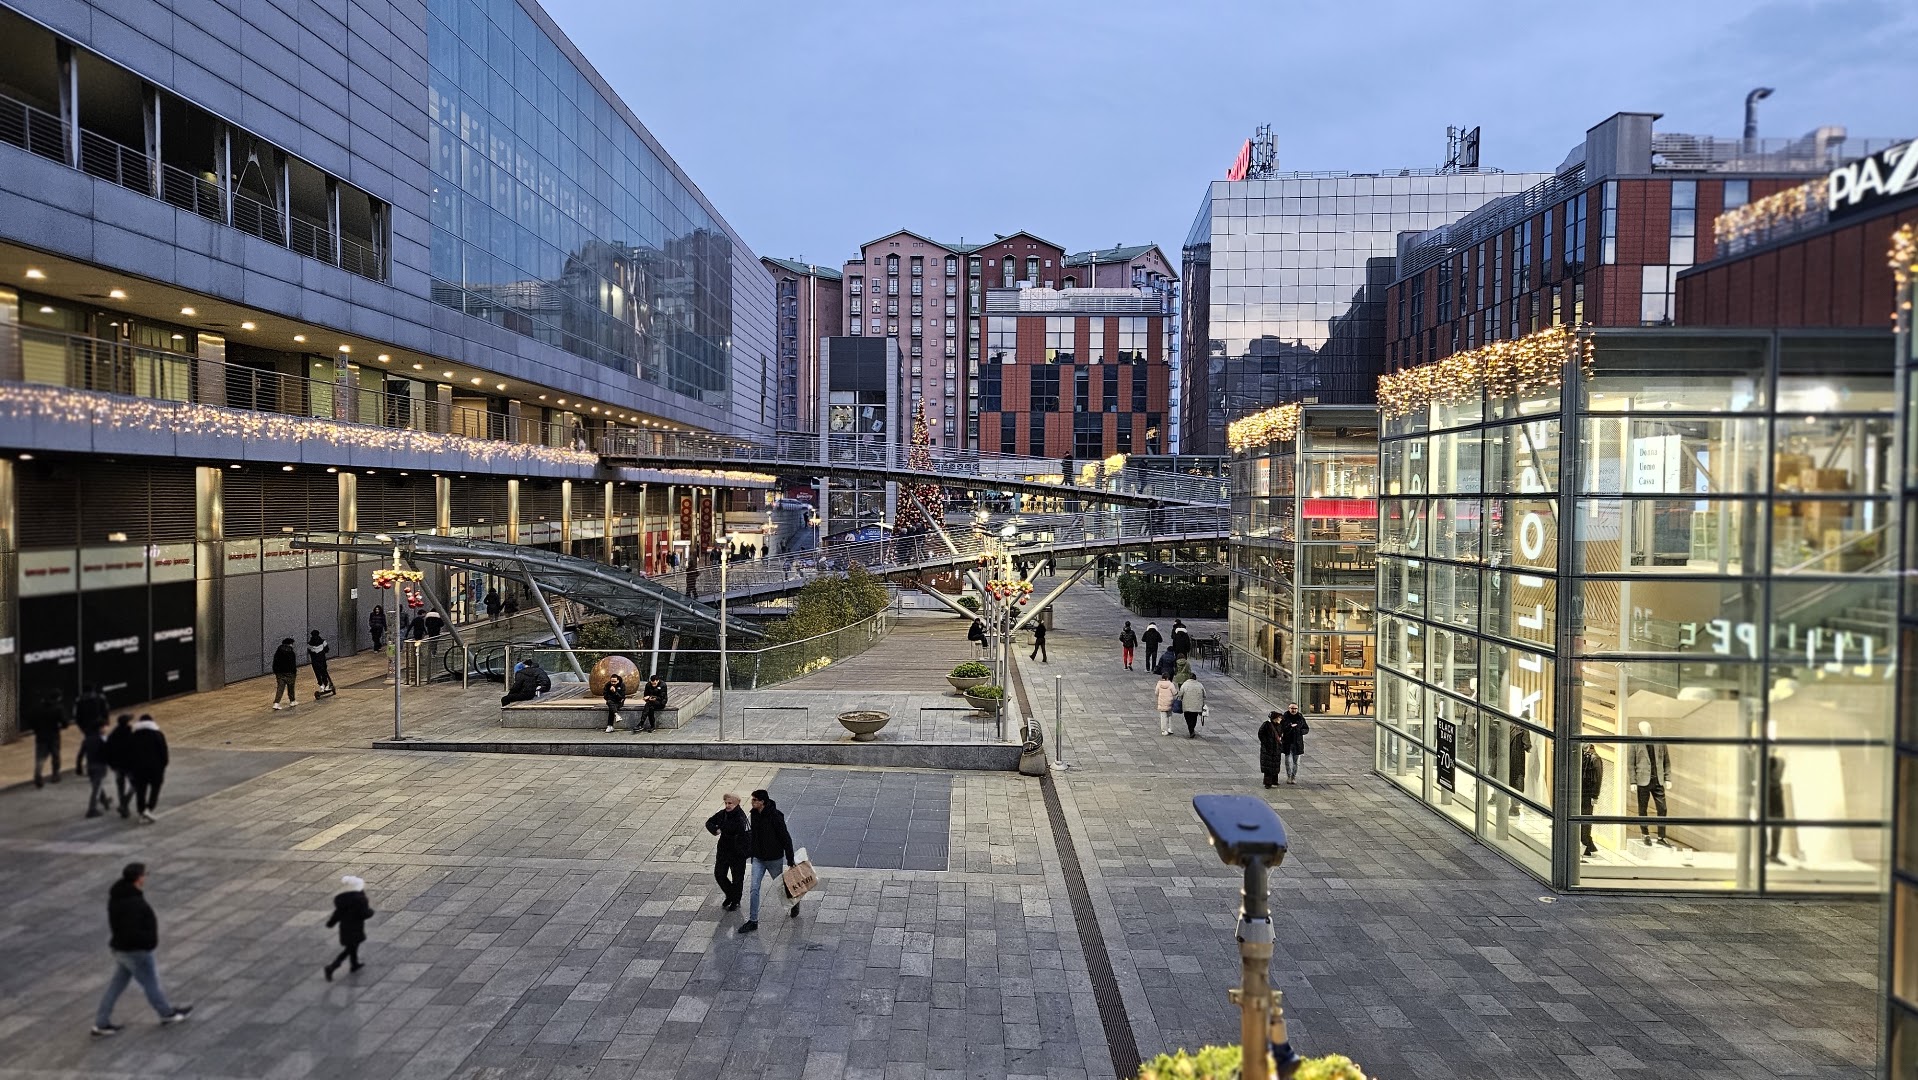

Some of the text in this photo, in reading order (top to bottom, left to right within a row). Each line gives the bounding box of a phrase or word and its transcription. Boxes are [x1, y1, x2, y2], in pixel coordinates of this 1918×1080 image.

[1438, 720, 1454, 734] BLACK
[1440, 729, 1453, 743] DAYS
[792, 875, 813, 891] KIABI
